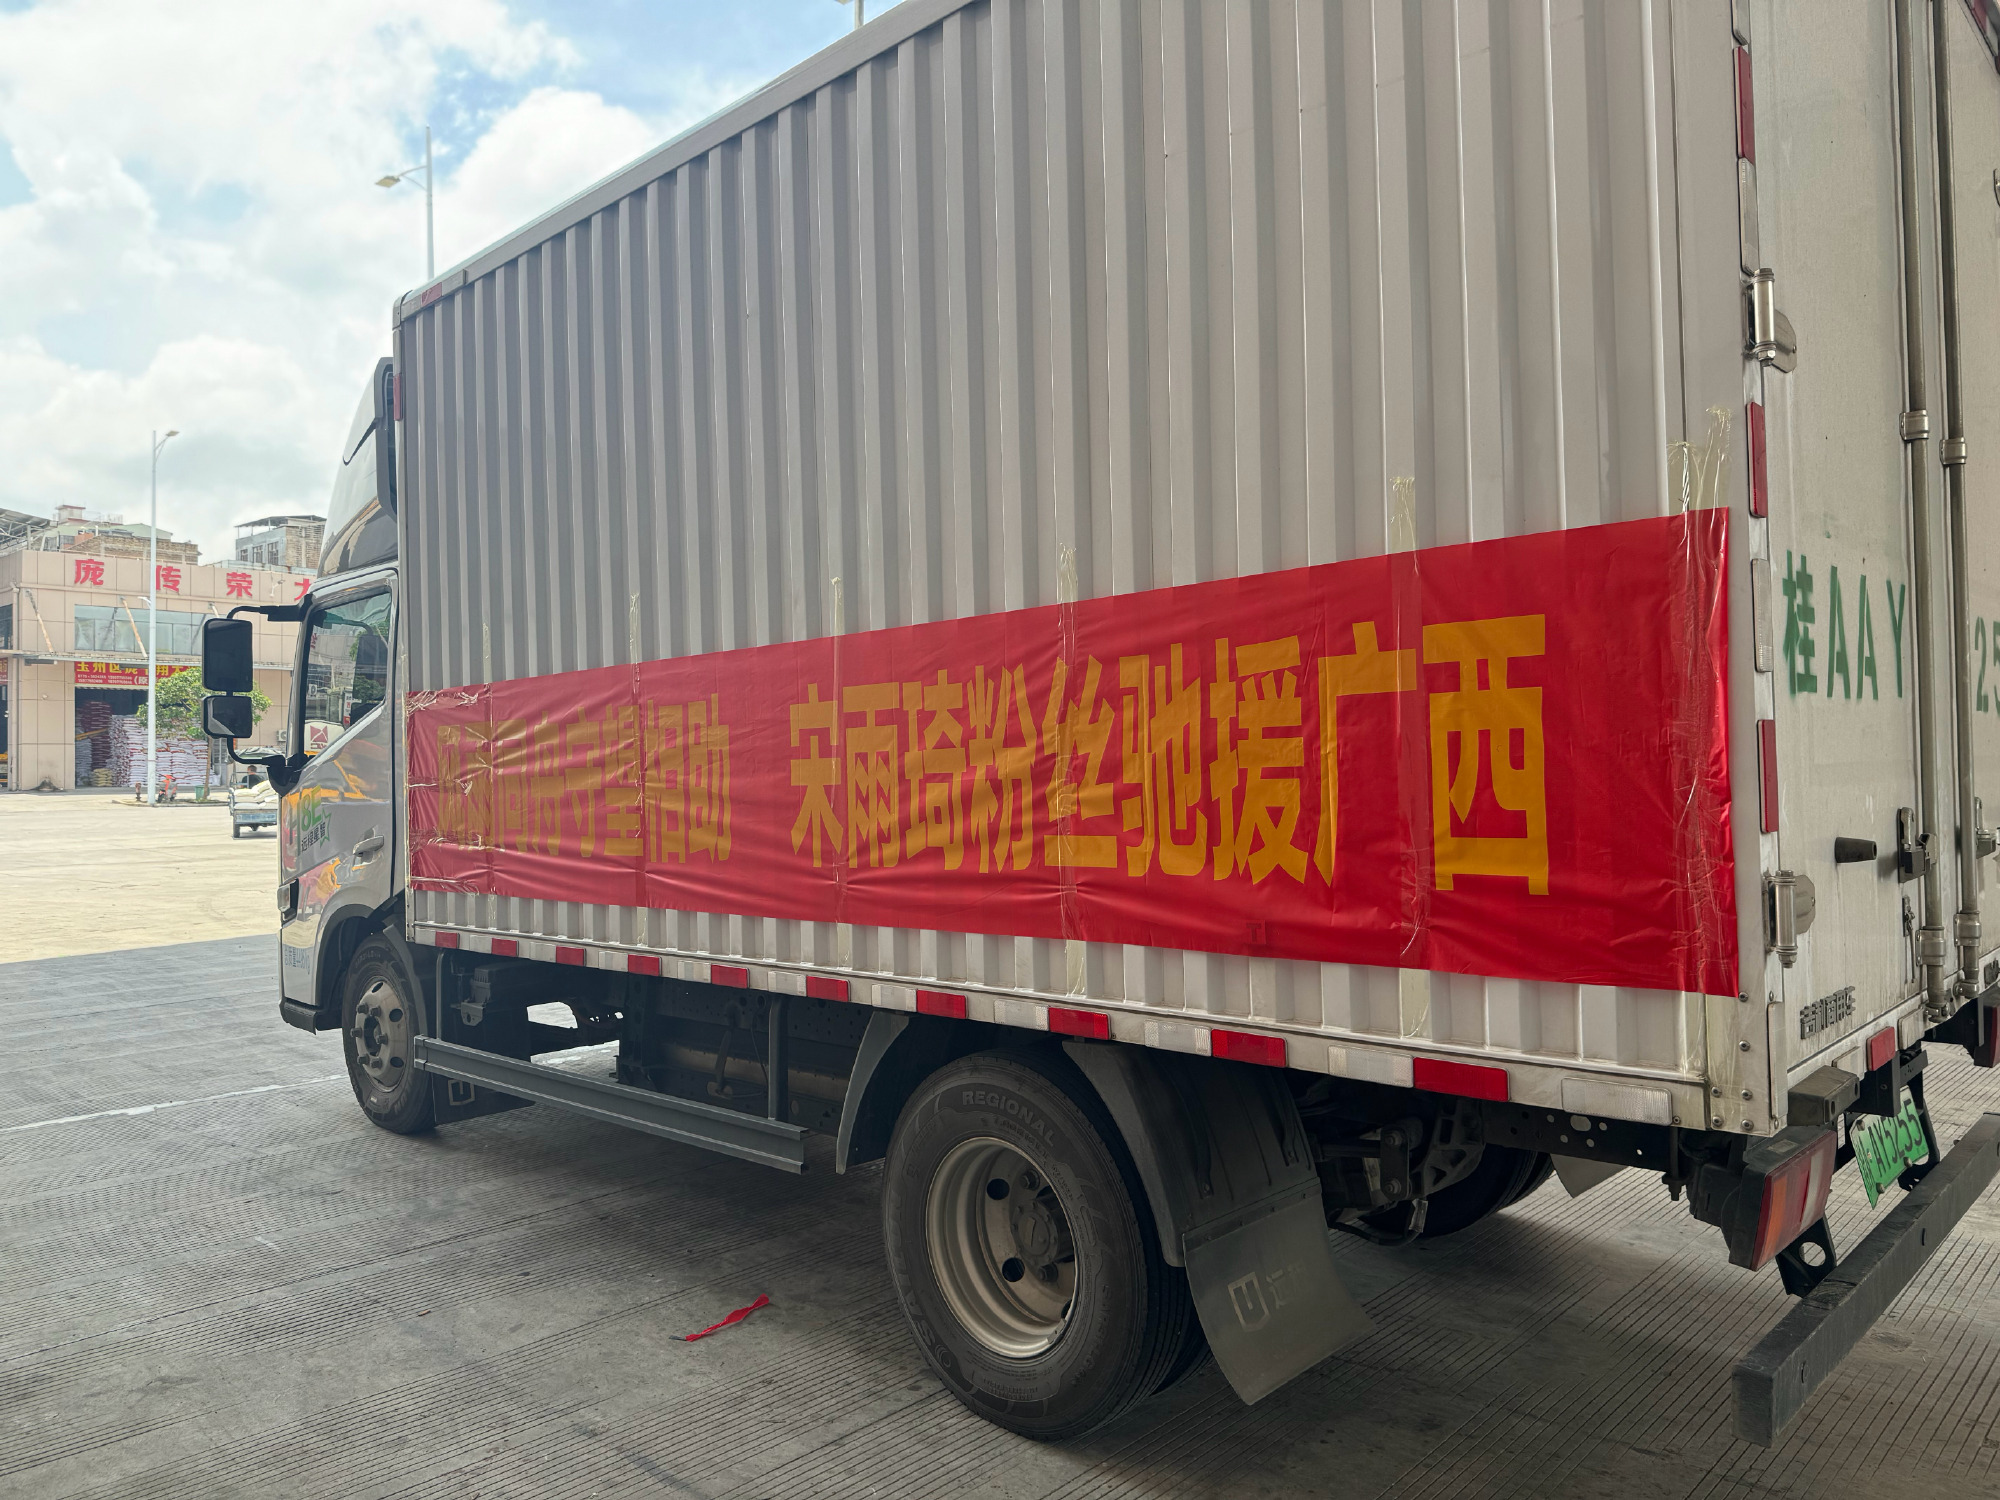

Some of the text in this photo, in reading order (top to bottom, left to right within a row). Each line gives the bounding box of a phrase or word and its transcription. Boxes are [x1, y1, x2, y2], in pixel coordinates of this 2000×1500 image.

[1783, 549, 1906, 700] 桂AAY
[790, 614, 1549, 895] 宋雨琦粉丝驰援广西
[962, 1090, 1057, 1144] REGIONAL
